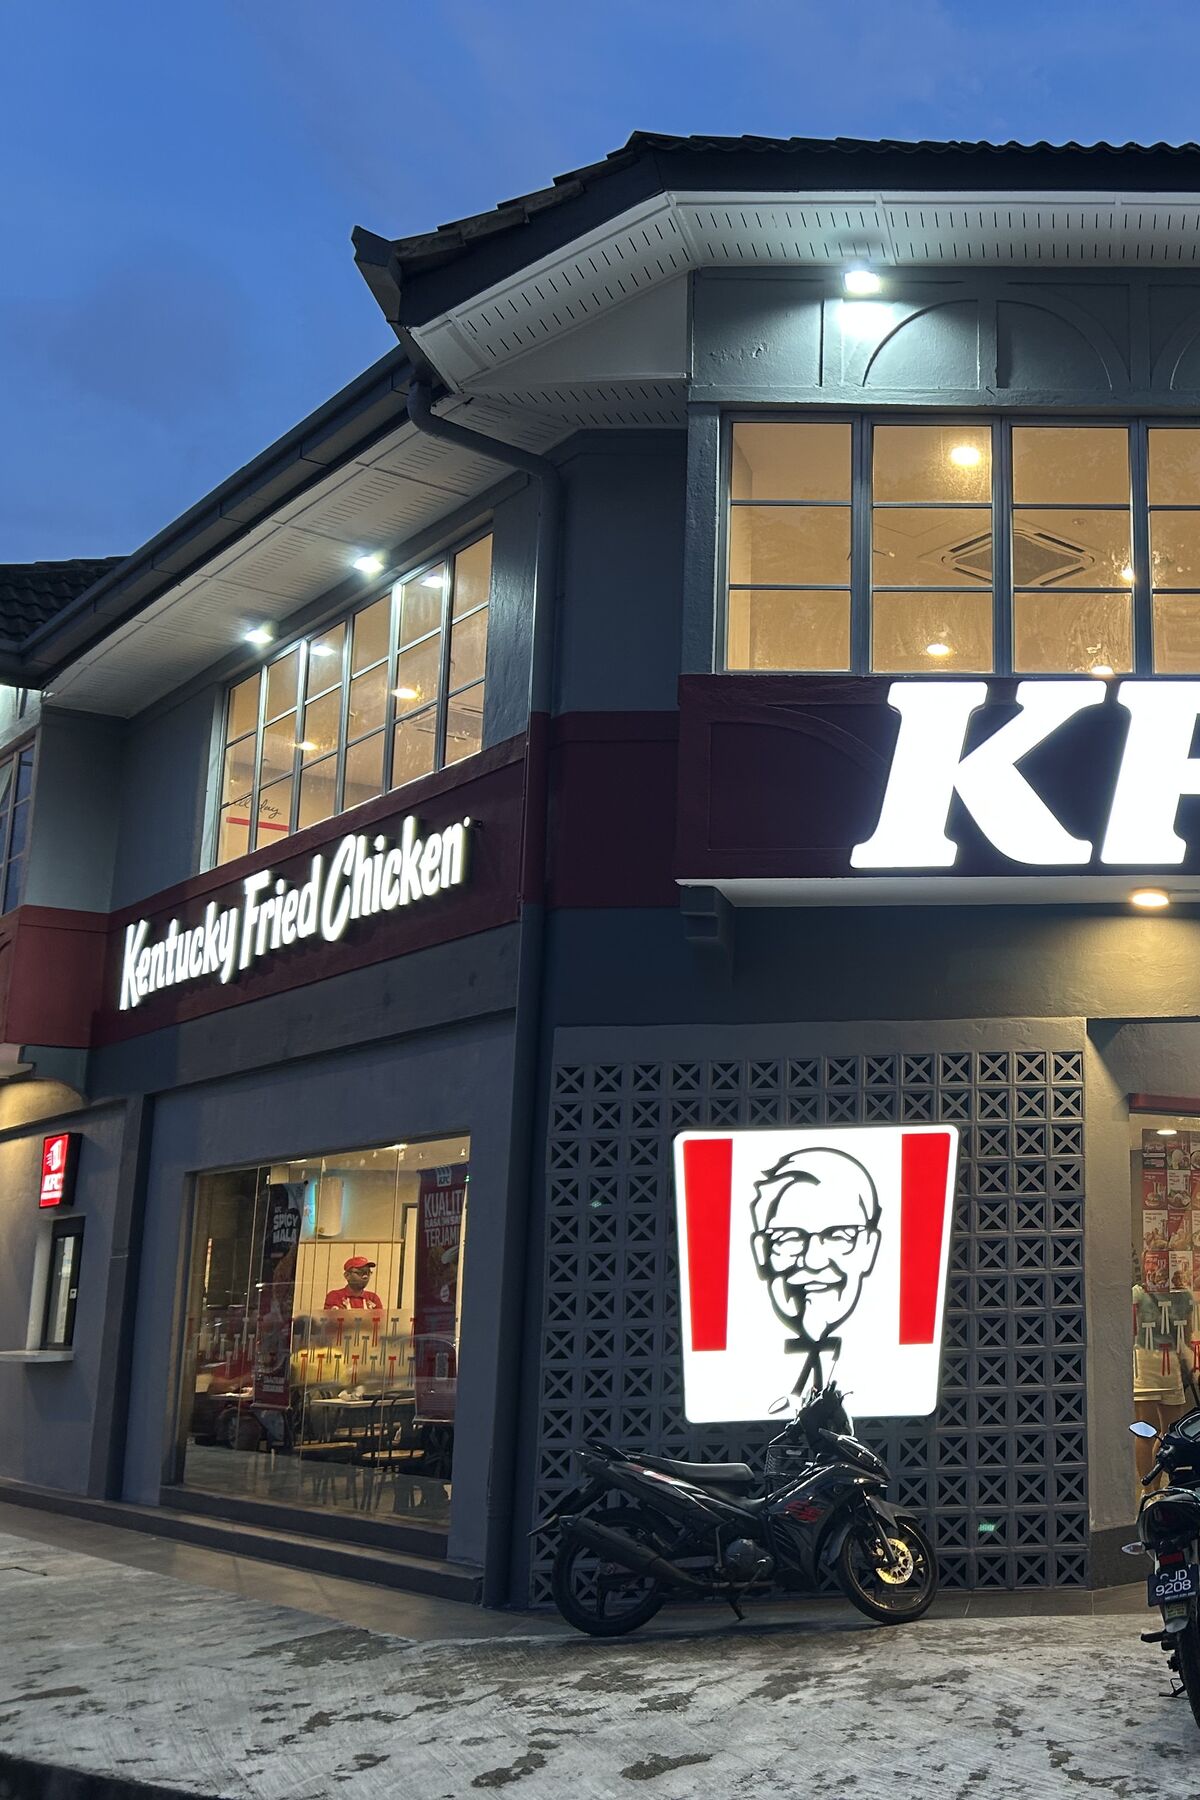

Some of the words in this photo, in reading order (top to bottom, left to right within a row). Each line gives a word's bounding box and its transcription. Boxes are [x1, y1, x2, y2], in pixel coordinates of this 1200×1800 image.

[119, 900, 239, 1012] Kentucky
[239, 853, 323, 971] Fried
[321, 814, 467, 942] Chicken
[273, 1212, 298, 1230] SPICY
[272, 1228, 297, 1244] MALA
[1155, 1579, 1192, 1597] 9208
